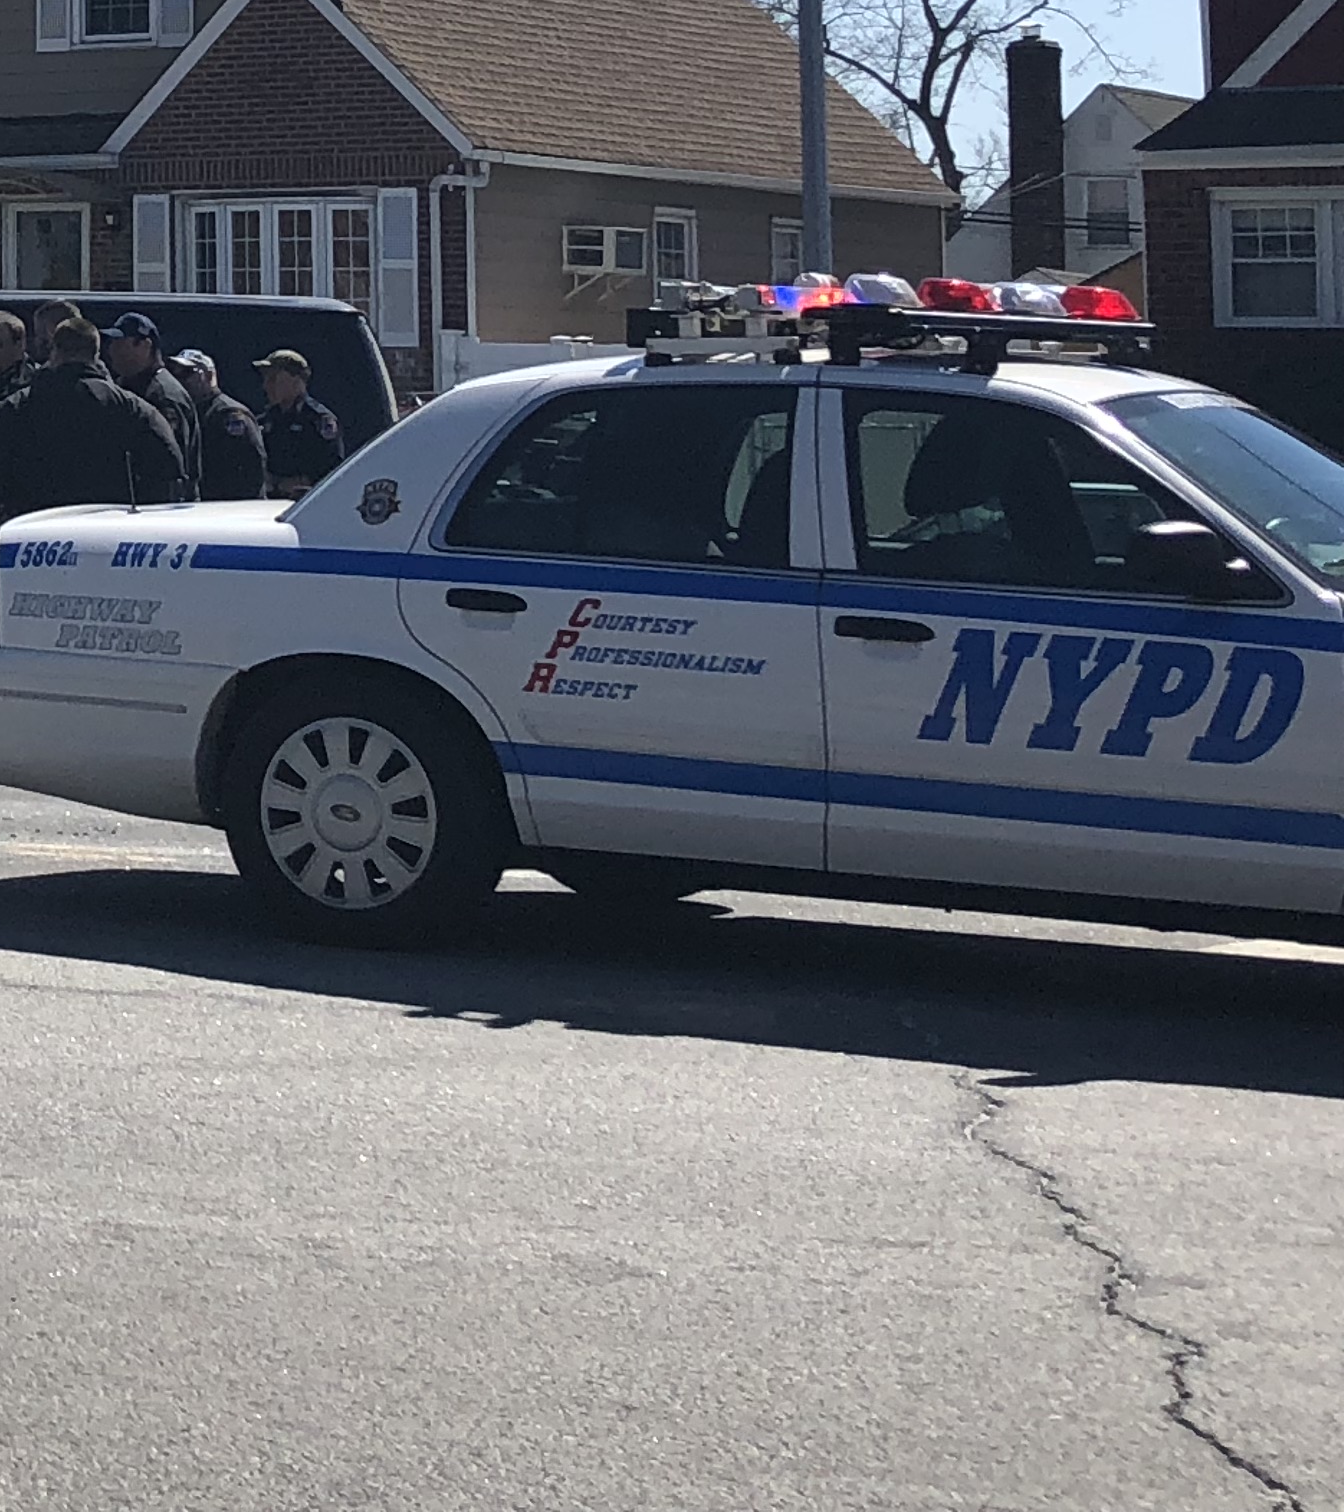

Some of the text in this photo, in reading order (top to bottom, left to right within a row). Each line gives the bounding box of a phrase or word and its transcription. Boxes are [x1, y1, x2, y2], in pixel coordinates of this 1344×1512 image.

[20, 541, 73, 568] 5862
[110, 541, 189, 570] HWY 3
[8, 591, 163, 625] HIGHWAY
[55, 623, 183, 655] PATROL
[917, 627, 1306, 765] NYPD
